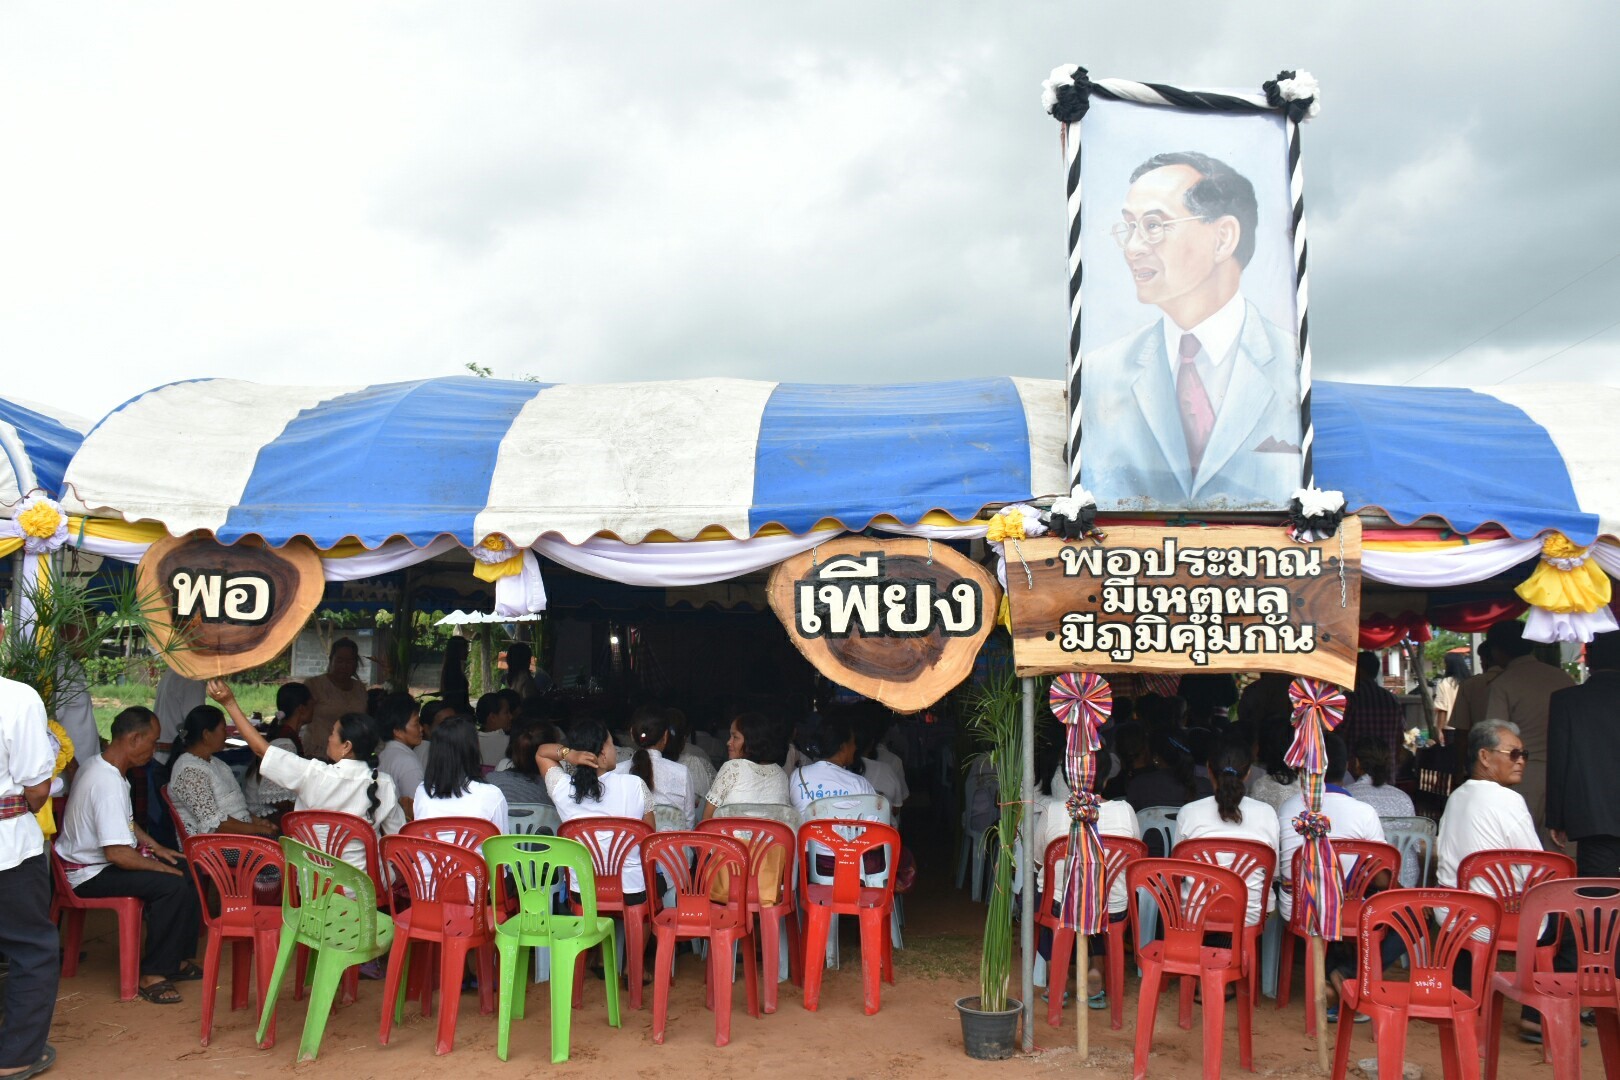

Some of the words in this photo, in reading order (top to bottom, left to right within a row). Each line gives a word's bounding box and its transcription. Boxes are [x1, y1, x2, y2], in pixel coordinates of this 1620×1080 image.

[1062, 539, 1320, 577] พอประมาณ
[172, 571, 270, 621] พอ
[799, 556, 977, 633] เพียง
[1103, 577, 1288, 623] มีเหตุผล
[1061, 614, 1314, 663] มีภูมิคุ้มกัน
